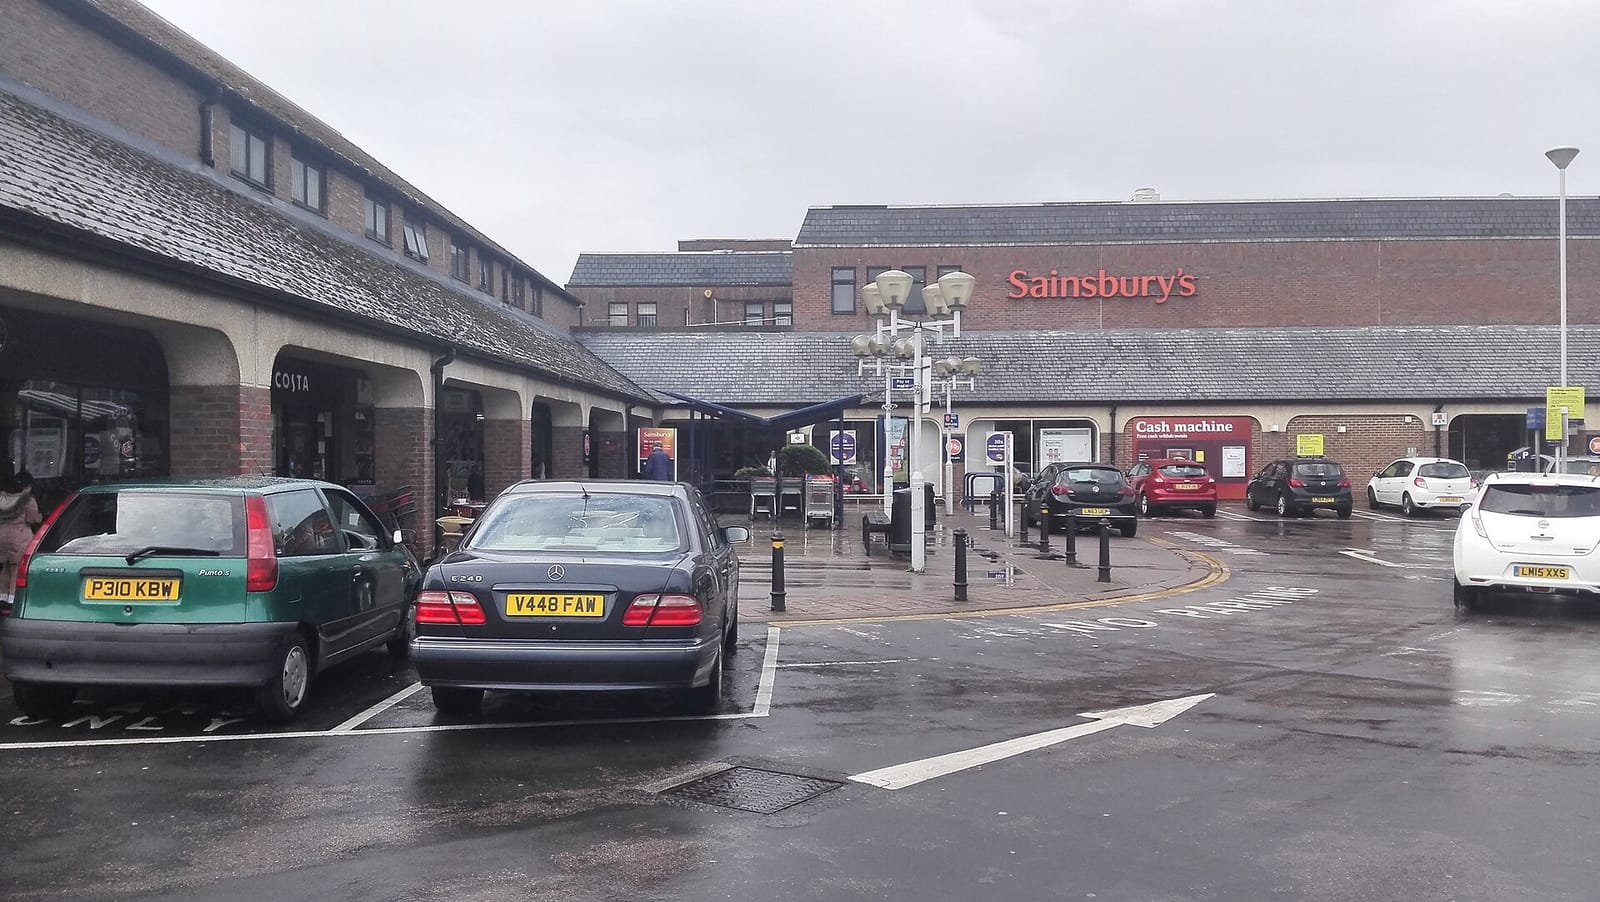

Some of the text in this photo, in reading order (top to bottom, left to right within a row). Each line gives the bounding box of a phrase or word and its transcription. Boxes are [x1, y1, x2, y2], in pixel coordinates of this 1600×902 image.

[1008, 268, 1196, 304] Sainsbury's
[275, 371, 309, 392] COSTA
[1135, 420, 1233, 433] Cash machine
[1521, 567, 1566, 578] LM15 XXS
[92, 580, 172, 597] P310 KBW
[515, 596, 596, 612] V448 FAW
[1040, 617, 1158, 638] NO
[1153, 586, 1320, 618] PARKING
